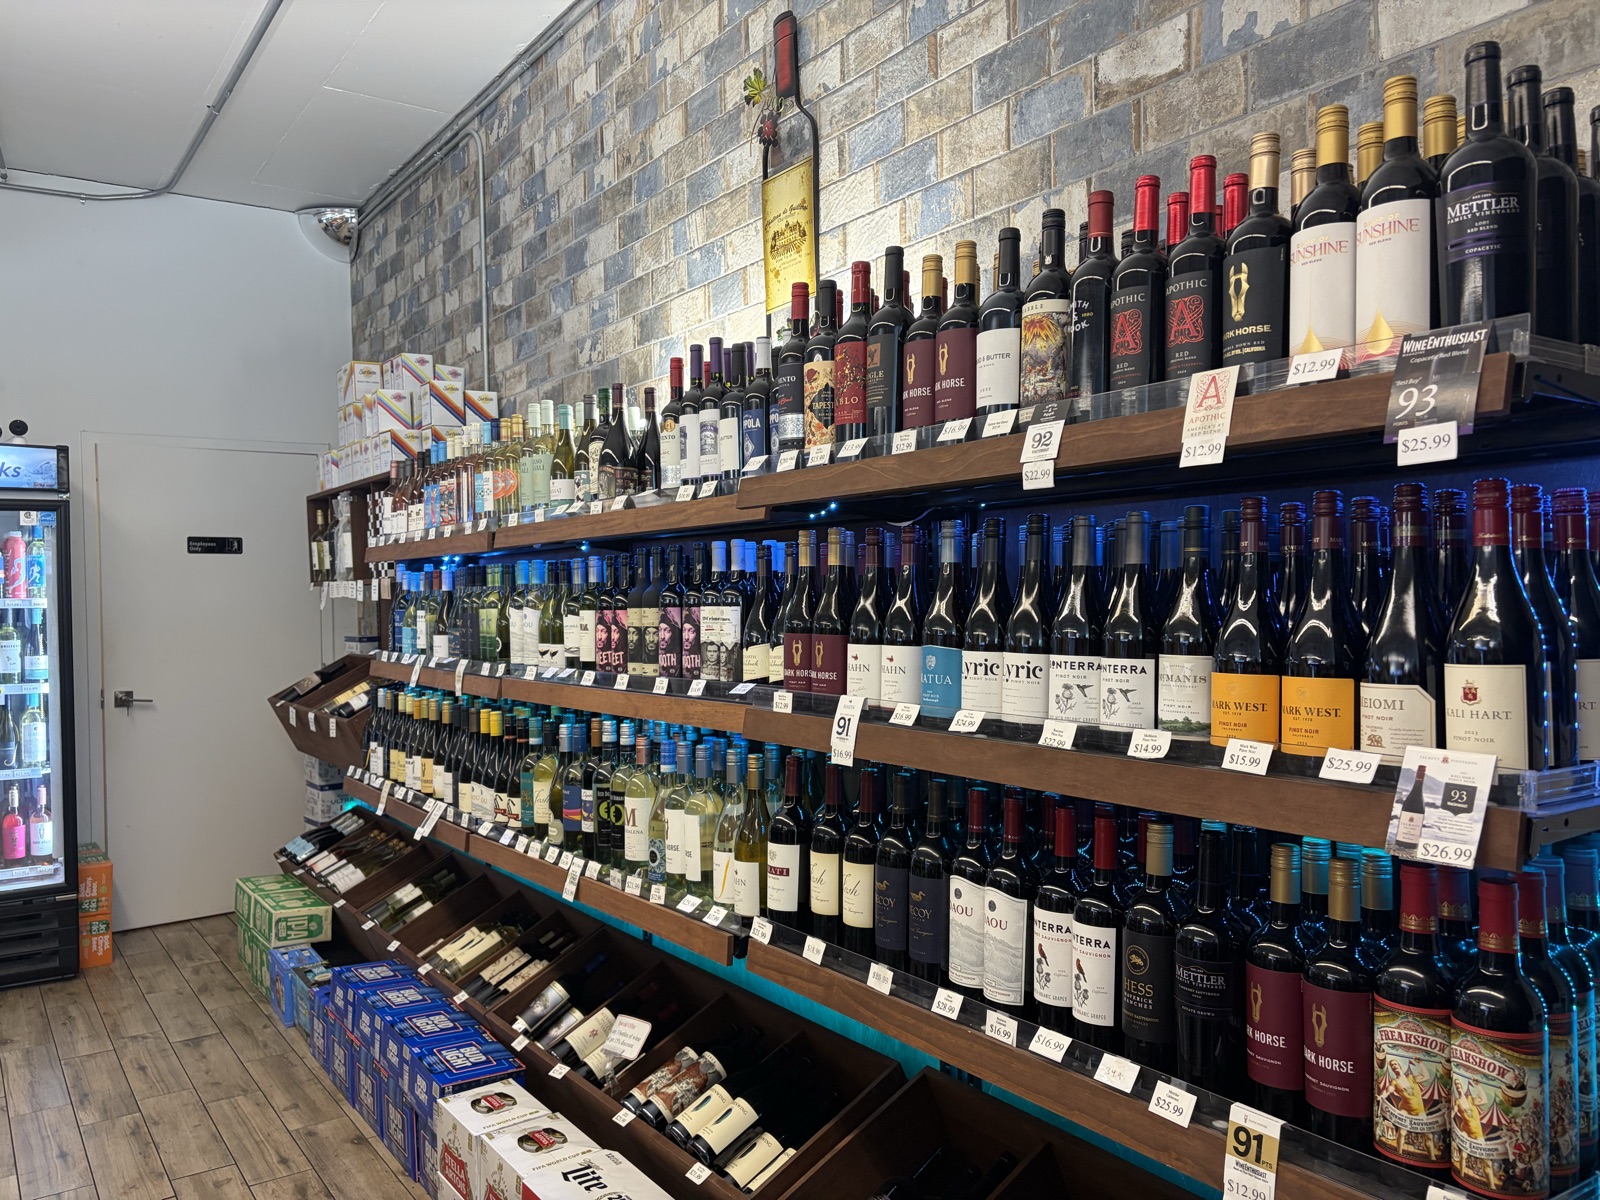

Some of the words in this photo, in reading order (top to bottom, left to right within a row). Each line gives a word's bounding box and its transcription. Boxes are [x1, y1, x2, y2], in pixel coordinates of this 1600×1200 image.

[1447, 197, 1519, 221] METTLER
[1447, 214, 1471, 225] FAMILY
[1475, 208, 1519, 217] VINEYARDS
[1465, 243, 1501, 254] COPACETIC
[986, 352, 1011, 362] BUTTER
[1175, 350, 1190, 359] RED
[1451, 348, 1470, 359] Blend
[1116, 362, 1129, 371] RED
[1292, 358, 1336, 376] $12.99
[1395, 384, 1439, 420] 93
[1187, 411, 1227, 425] APOTHIC
[1031, 429, 1053, 450] 92
[1203, 428, 1221, 437] BLEND
[1184, 442, 1222, 459] $12.99
[1401, 433, 1452, 454] $25.99
[1025, 468, 1051, 482] $22.99
[189, 541, 217, 549] Employees
[962, 658, 1000, 680] yric
[1101, 663, 1147, 675] NTERRA
[775, 702, 788, 711] $12.99
[893, 713, 912, 722] $16.99
[955, 719, 975, 728] $24.99
[836, 716, 852, 737] 91
[1289, 726, 1301, 734] PINOT
[1042, 738, 1066, 748] $22.99
[1453, 735, 1471, 743] PINOT
[832, 748, 851, 761] $16.99
[1133, 743, 1162, 754] $14.99
[1229, 754, 1261, 768] $15.99
[1326, 756, 1372, 774] $25.99
[1450, 789, 1467, 802] 93
[1421, 842, 1472, 861] $26.99
[287, 915, 309, 940] IPA
[984, 916, 1008, 931] AOU
[1042, 934, 1072, 944] SAUVIGNON
[1079, 949, 1111, 959] SAUVIGNON
[1175, 964, 1226, 988] METTLER
[1123, 976, 1154, 998] HESS
[1192, 982, 1227, 991] VINEYARDS
[1052, 993, 1068, 1003] GRAPES
[935, 1000, 956, 1015] $28.99
[1196, 1010, 1216, 1019] GROWN
[429, 1014, 454, 1029] BUD
[1090, 1011, 1107, 1023] GRAPES
[412, 1016, 441, 1034] LIGHT
[990, 1024, 1011, 1039] $16.99
[1035, 1034, 1065, 1052] $16.99
[1378, 1029, 1449, 1055] FREAKSHOW
[441, 1048, 472, 1069] LIGHT
[459, 1046, 487, 1063] BUD
[1255, 1055, 1282, 1065] SAUVIGNON
[1304, 1045, 1317, 1064] ARK
[1319, 1081, 1350, 1094] SAUVIGNON
[1154, 1096, 1184, 1117] $25.99
[1232, 1125, 1264, 1165] 91
[1261, 1161, 1273, 1171] PTS
[444, 1152, 466, 1182] STELLA
[532, 1164, 546, 1172] FIFA
[546, 1157, 570, 1168] WORLD
[568, 1152, 580, 1160] CUP
[445, 1165, 467, 1196] ARTOIS
[561, 1163, 608, 1193] Lite
[1227, 1179, 1266, 1200] $12.99
